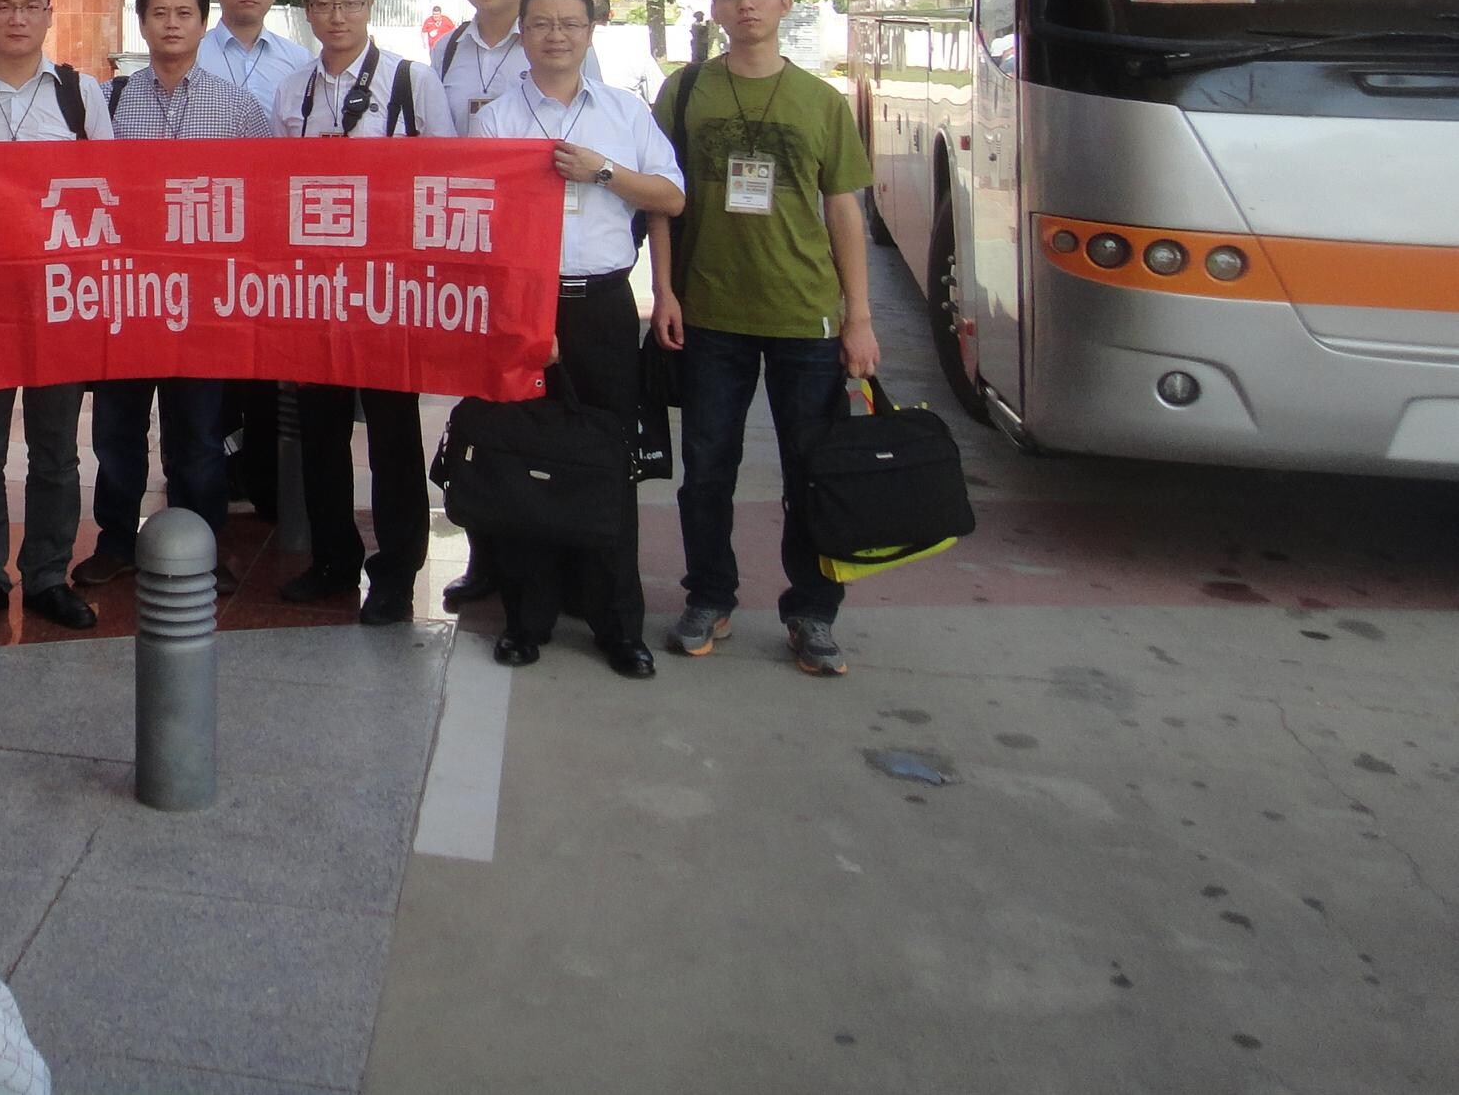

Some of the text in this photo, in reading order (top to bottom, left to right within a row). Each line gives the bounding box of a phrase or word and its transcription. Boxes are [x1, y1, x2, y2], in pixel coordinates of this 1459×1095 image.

[41, 175, 495, 252] 众和国际
[45, 258, 490, 335] Beijing Jonint-Union
